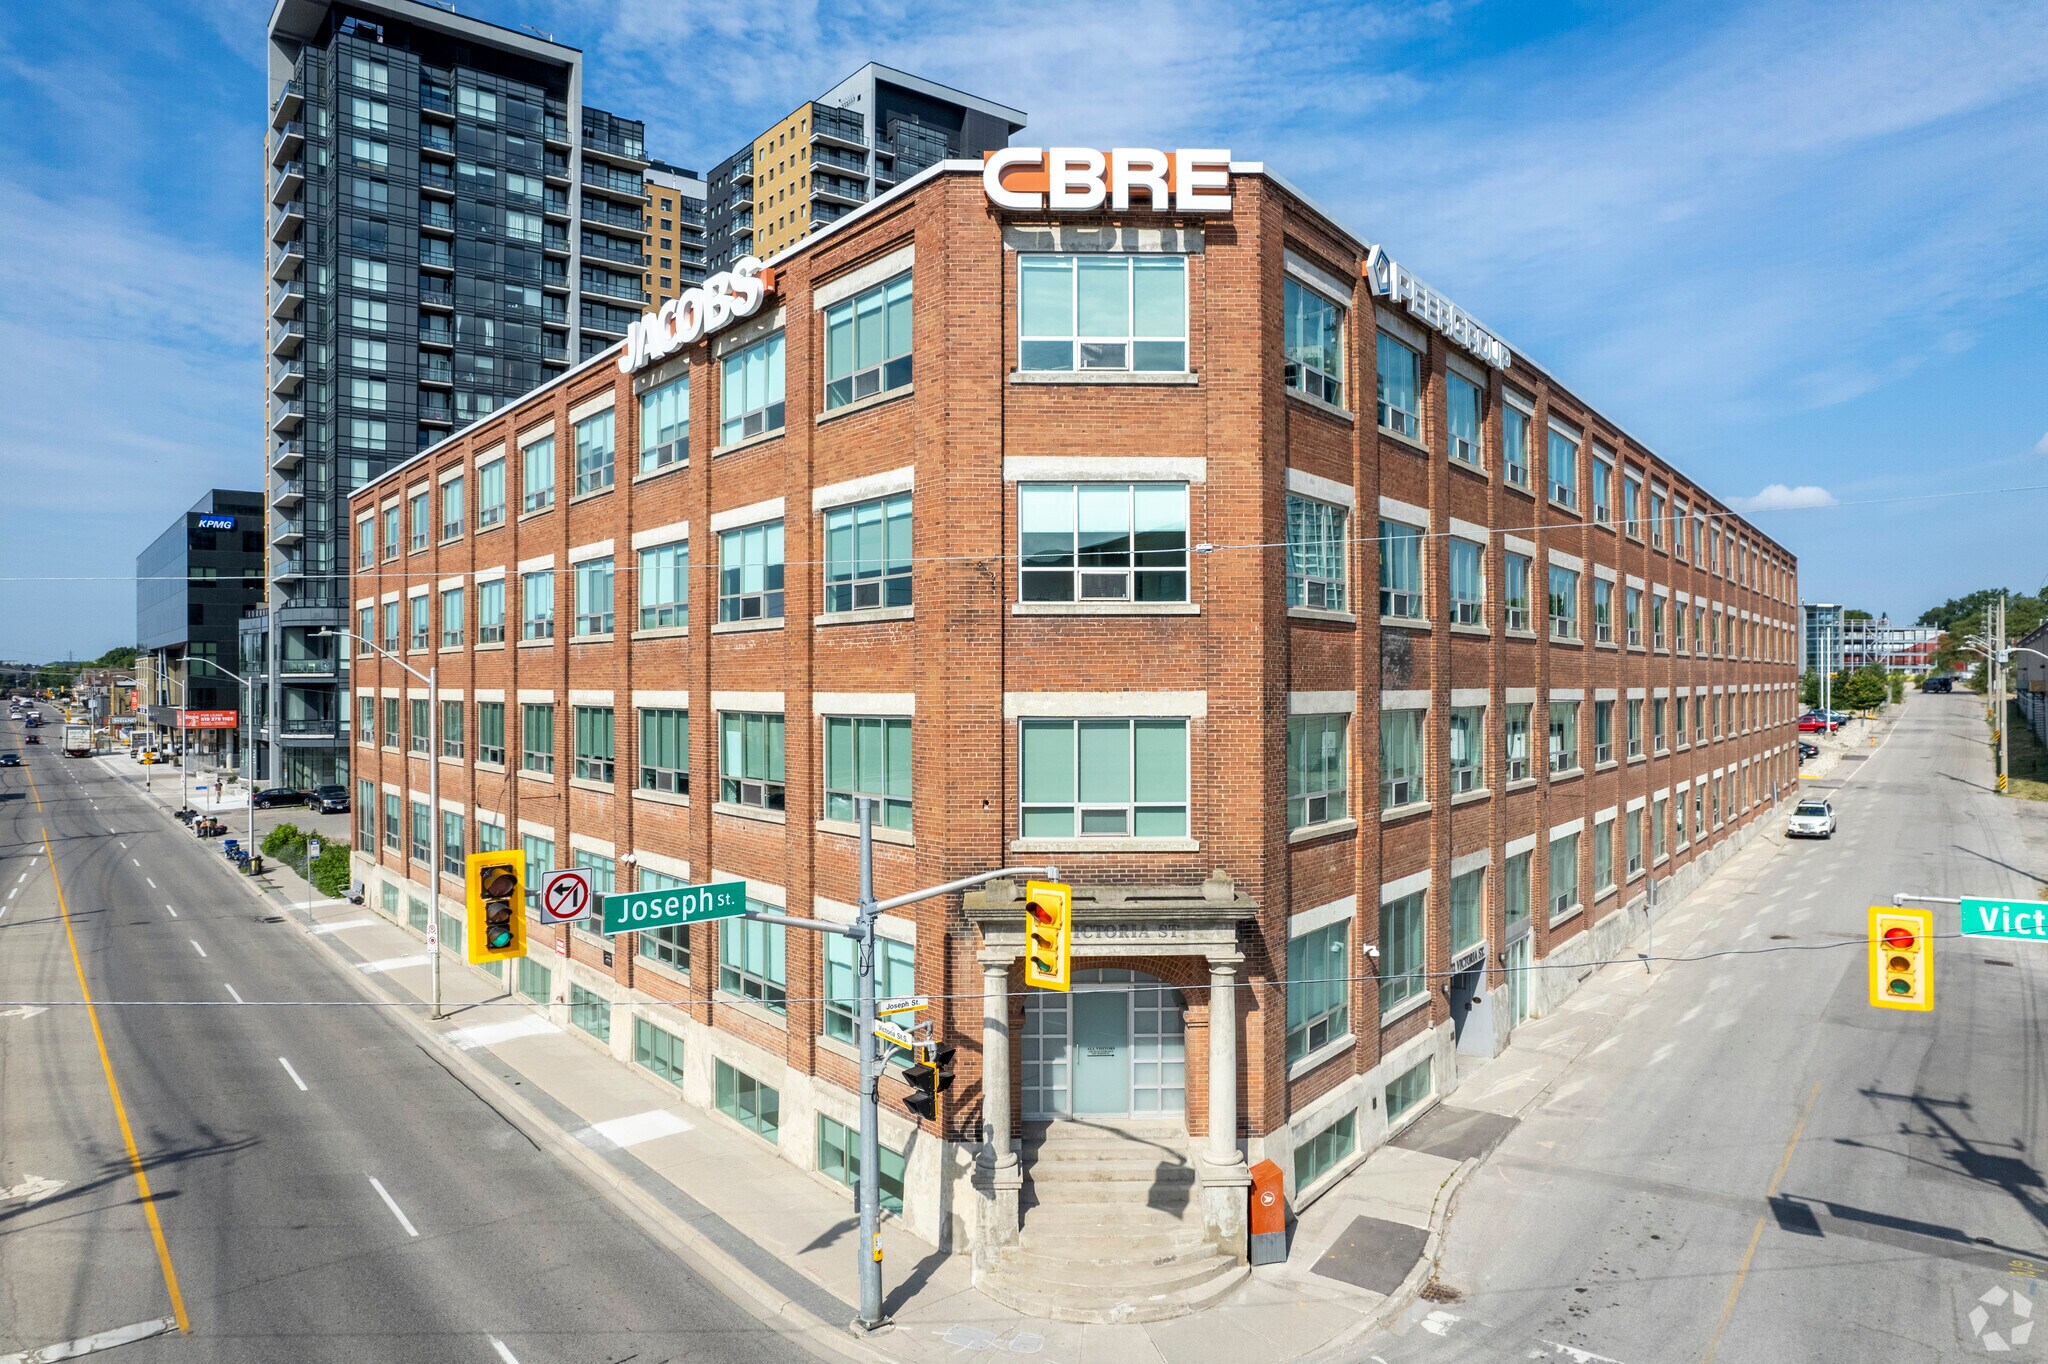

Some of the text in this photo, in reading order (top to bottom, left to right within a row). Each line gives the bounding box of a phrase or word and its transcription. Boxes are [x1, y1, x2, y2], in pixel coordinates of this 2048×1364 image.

[983, 147, 1231, 212] CBRE
[618, 255, 764, 374] JACOBS
[198, 520, 232, 529] KPMG
[617, 887, 713, 924] Joseph
[1979, 905, 2047, 936] Vict
[1072, 924, 1185, 939] ICTORIA ST.
[1456, 950, 1478, 971] VICTORIA
[885, 1001, 910, 1010] Joseph
[879, 1025, 896, 1038] Victoria
